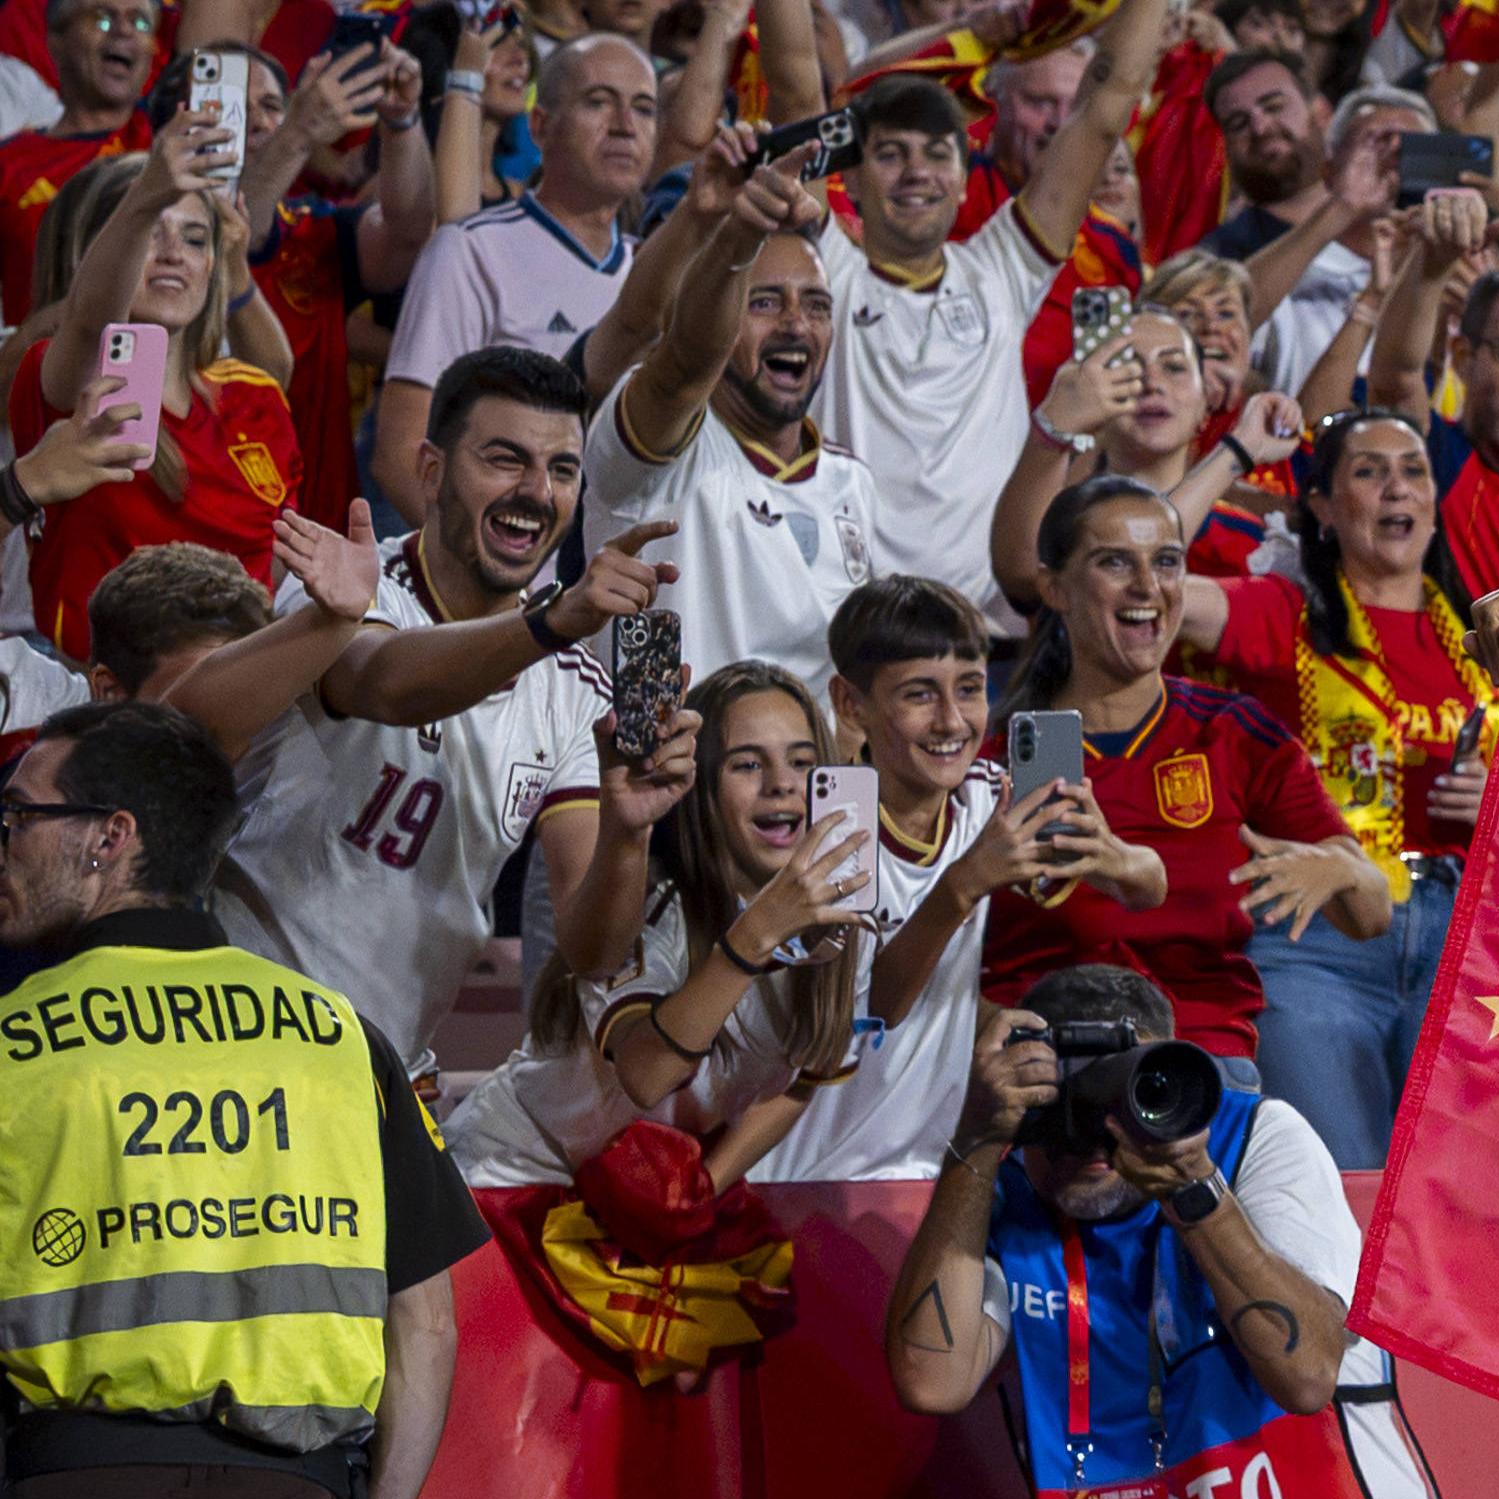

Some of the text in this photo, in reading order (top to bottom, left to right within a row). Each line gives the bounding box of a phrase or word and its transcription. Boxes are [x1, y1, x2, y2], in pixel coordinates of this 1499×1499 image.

[341, 761, 444, 870] 19
[0, 984, 343, 1061] SEGURIDAD
[118, 1087, 290, 1156] 2201
[97, 1194, 358, 1248] PROSEGUR
[1010, 1281, 1066, 1320] EF
